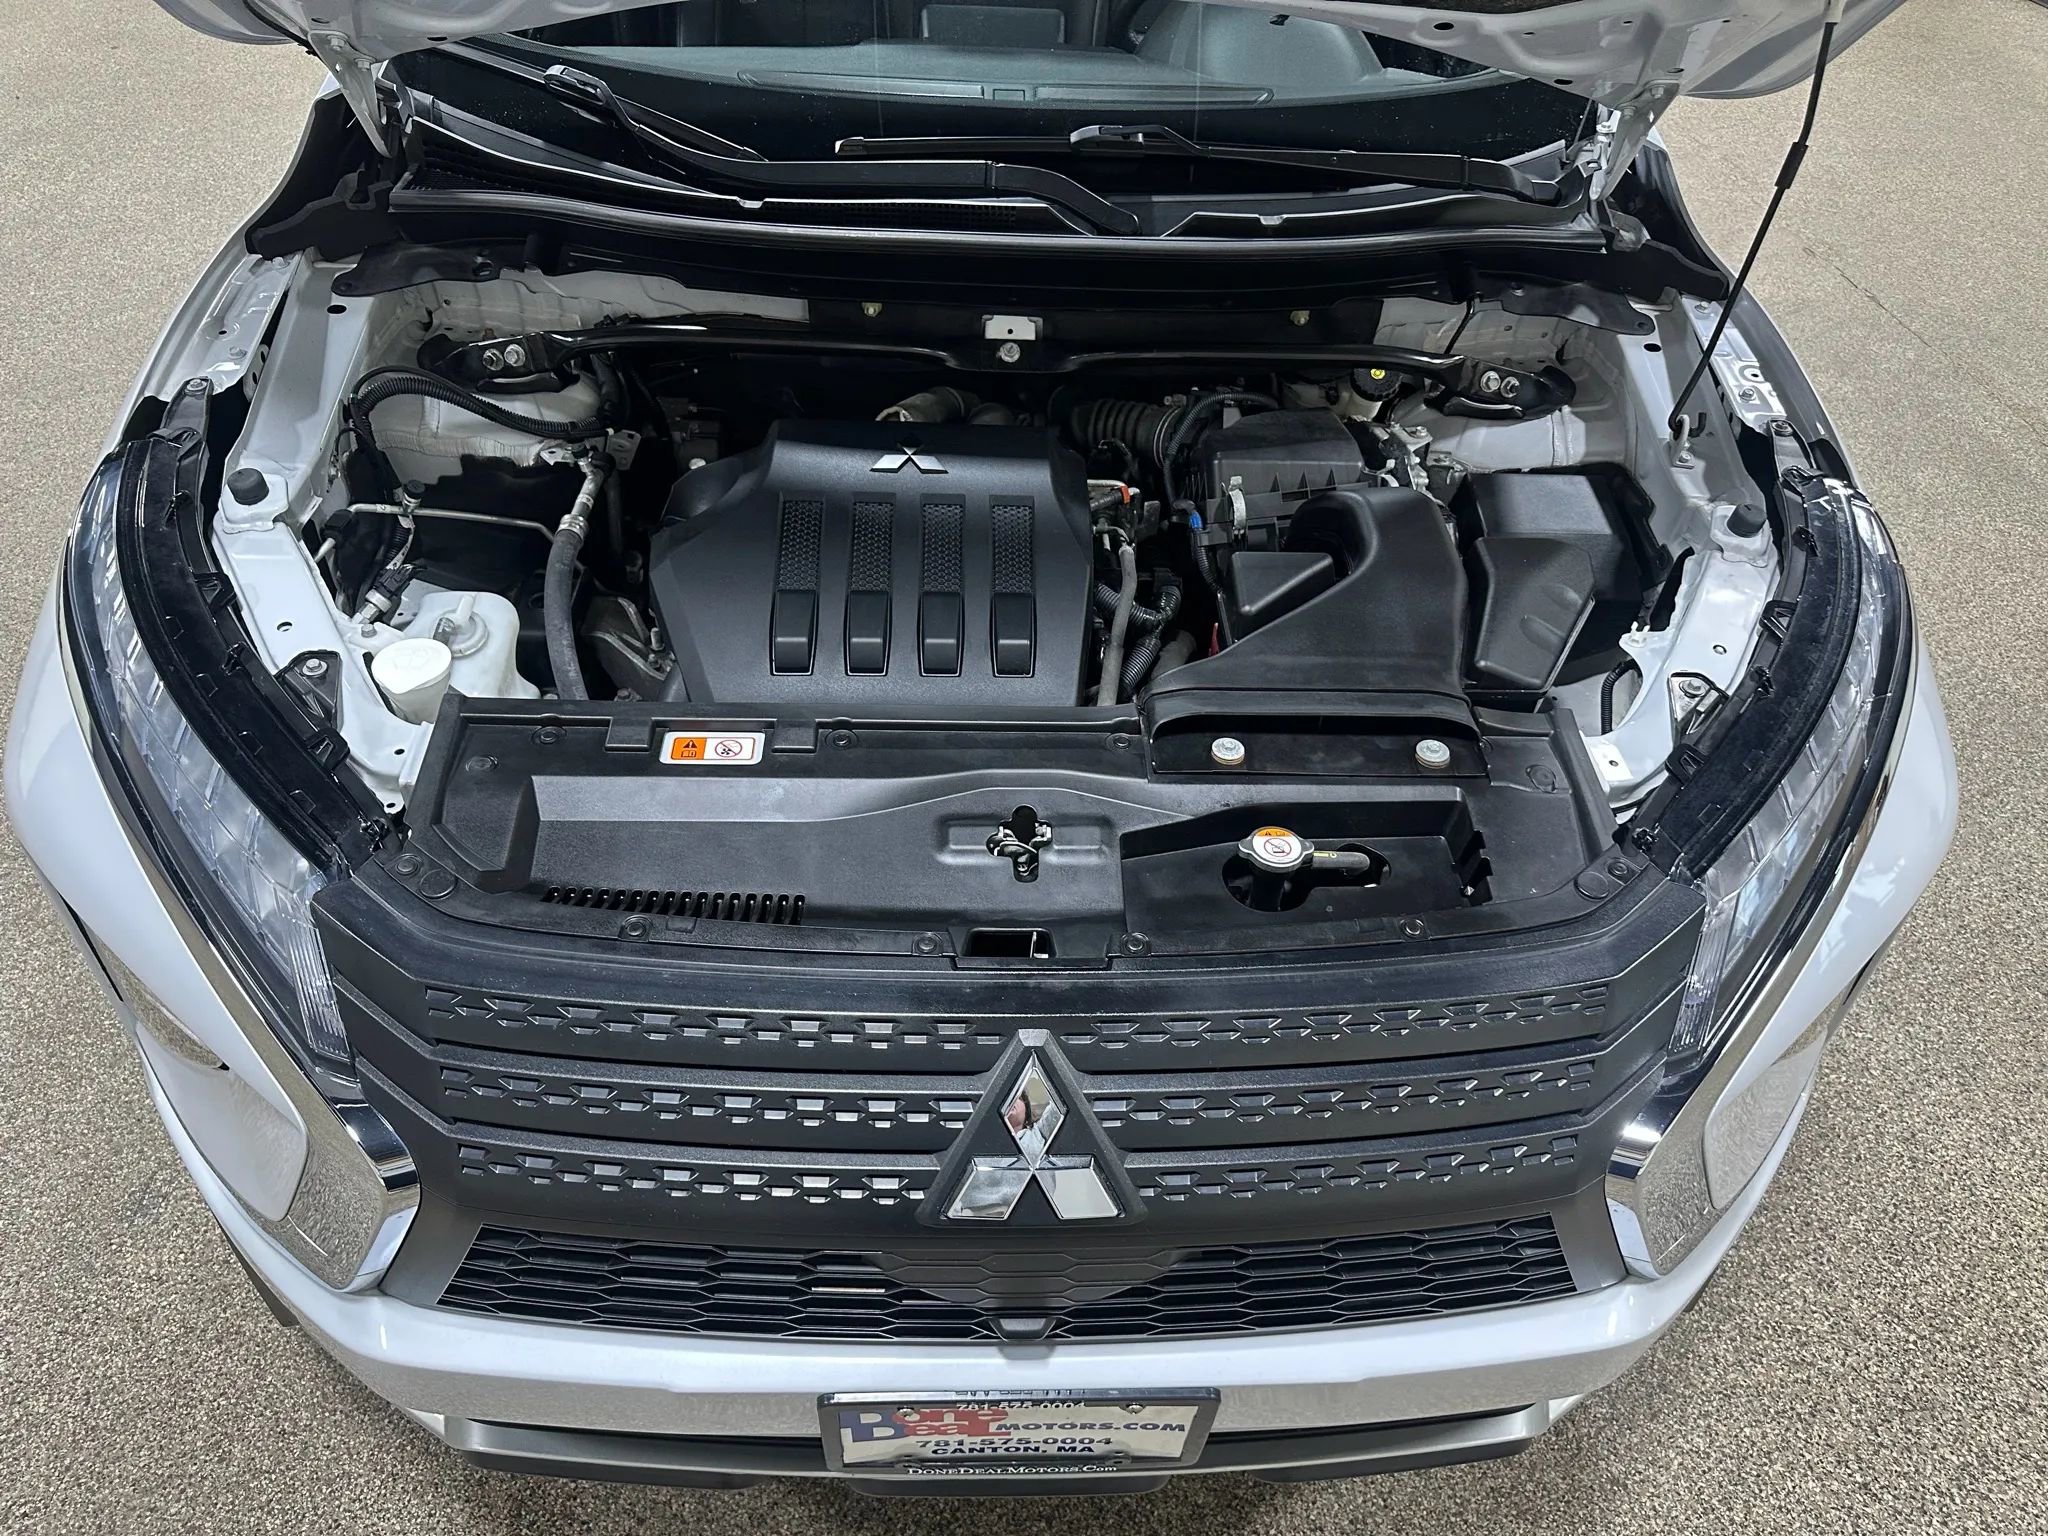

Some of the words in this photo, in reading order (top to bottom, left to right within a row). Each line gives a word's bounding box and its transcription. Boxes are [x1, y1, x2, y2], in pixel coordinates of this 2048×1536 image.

[996, 1422, 1185, 1432] MOTORS.COM
[916, 1437, 1112, 1447] 781-575-0004
[931, 1446, 1047, 1454] CANTON,
